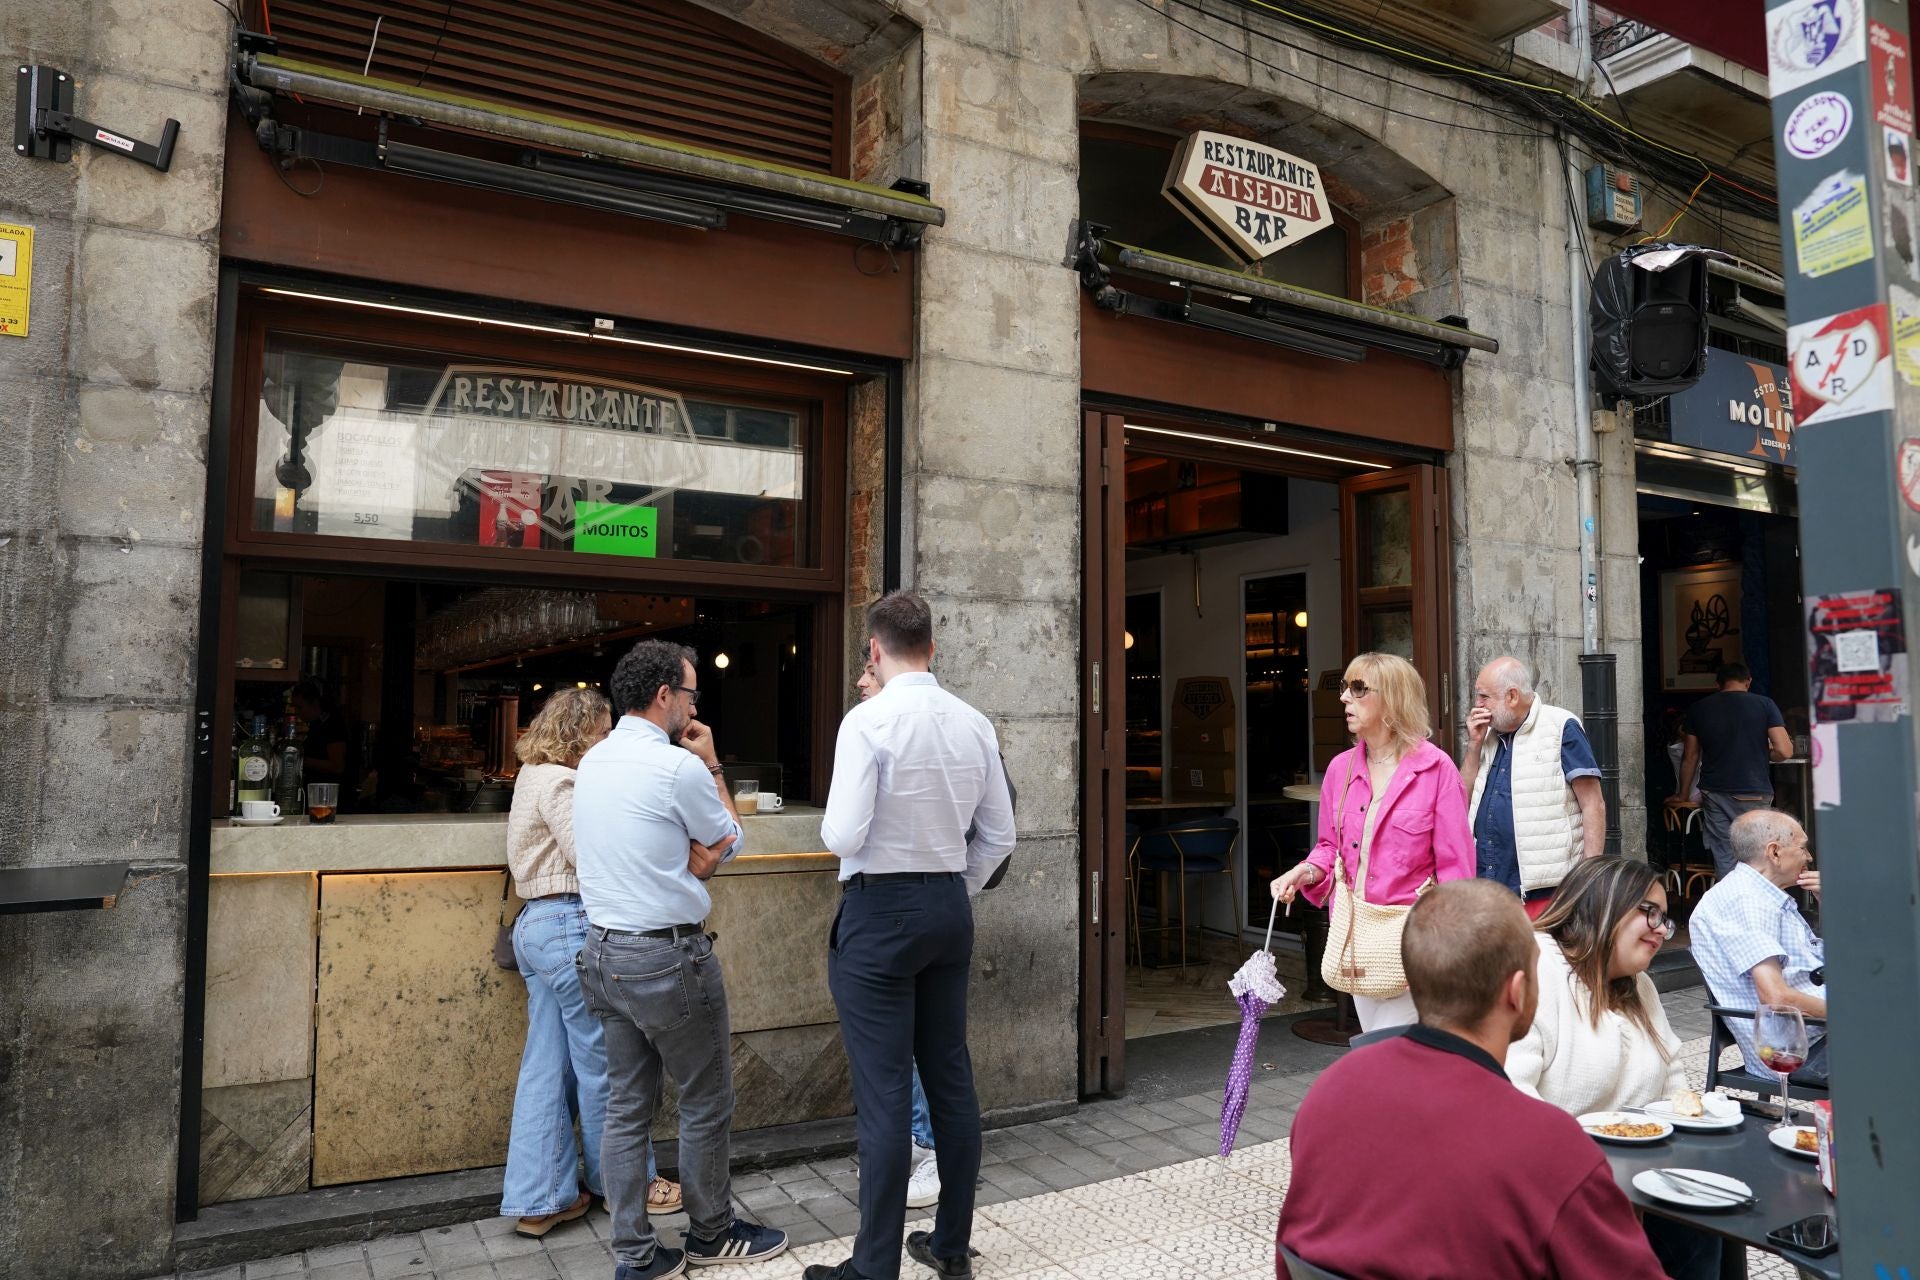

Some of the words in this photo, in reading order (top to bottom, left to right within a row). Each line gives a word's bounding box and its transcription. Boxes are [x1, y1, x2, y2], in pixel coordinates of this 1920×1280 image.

[1813, 129, 1836, 151] 30
[1204, 140, 1315, 190] RESTAURANTE
[1210, 169, 1311, 218] ATSEDEN
[1235, 205, 1288, 246] BAR
[1805, 350, 1821, 369] A
[1853, 339, 1867, 357] D
[1753, 382, 1775, 399] ESTD
[1831, 378, 1847, 396] R
[454, 377, 677, 434] RESTAURANTE
[354, 512, 379, 524] 5,50
[583, 522, 649, 538] MOJITOS
